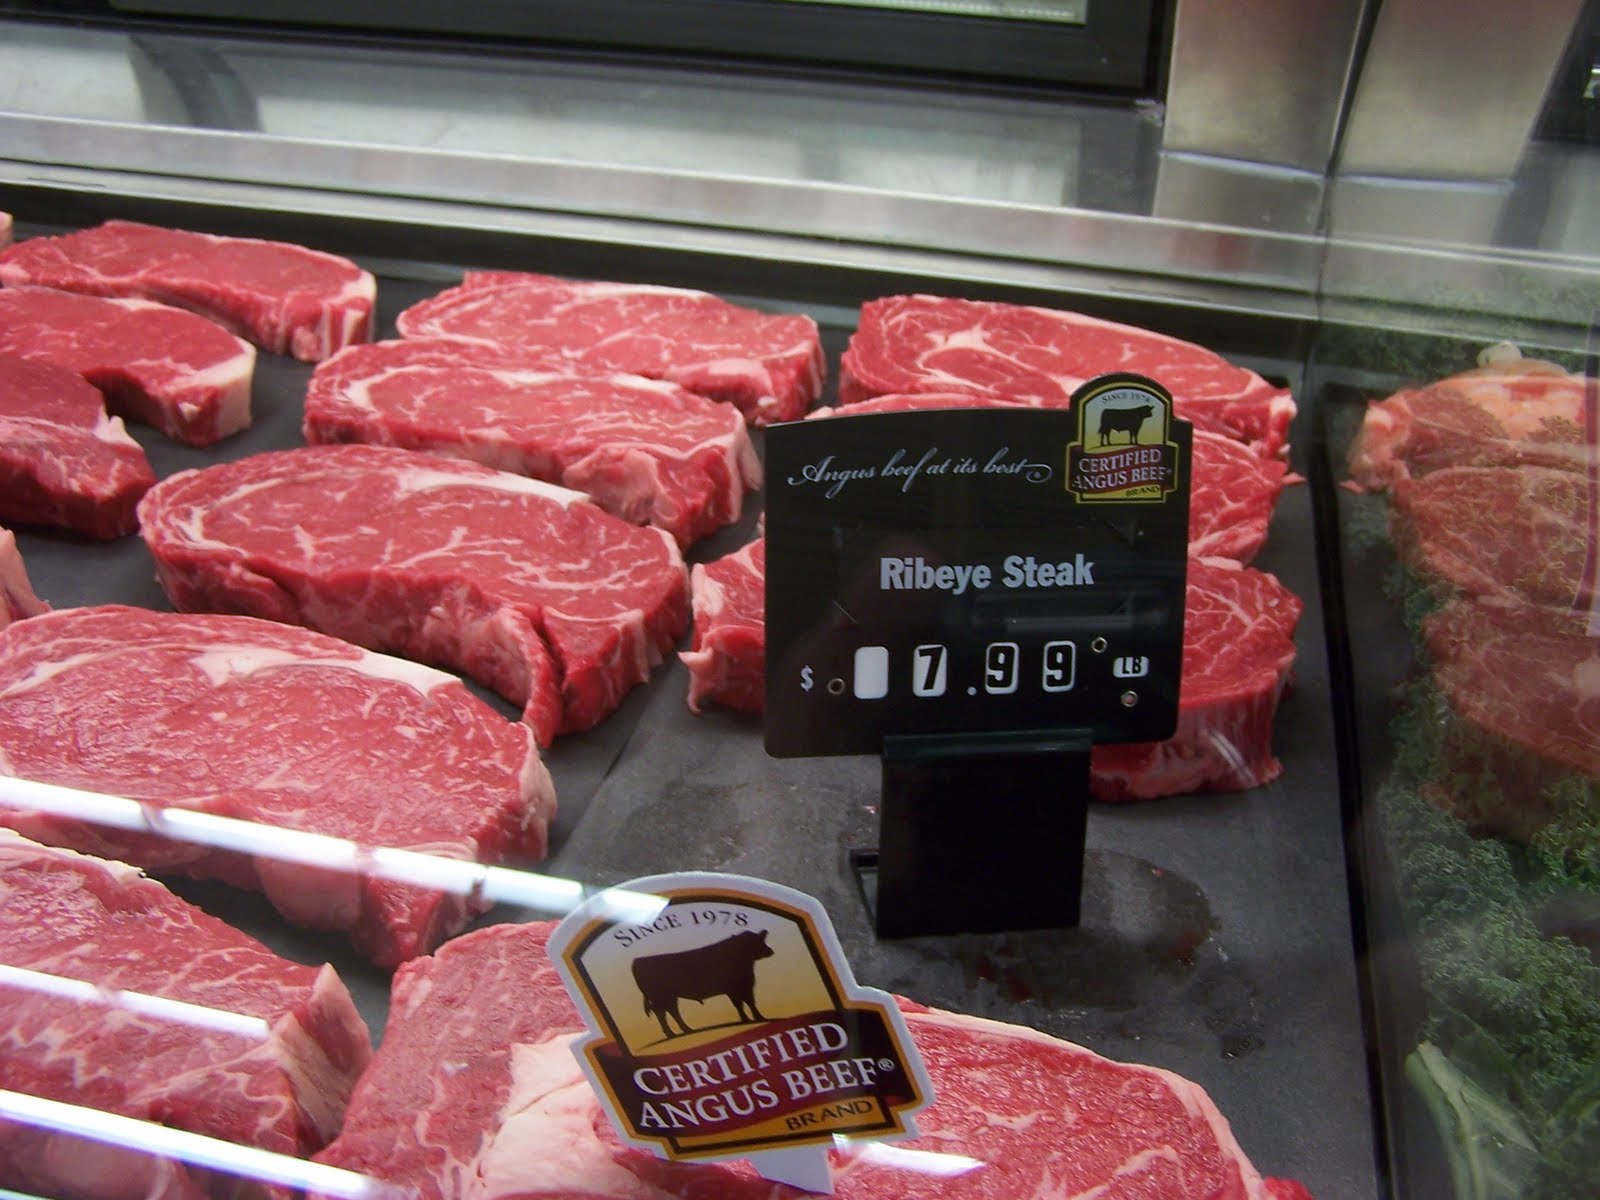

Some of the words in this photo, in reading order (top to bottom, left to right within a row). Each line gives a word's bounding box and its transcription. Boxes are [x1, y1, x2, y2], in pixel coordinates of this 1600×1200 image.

[787, 455, 875, 499] Angus
[880, 447, 937, 492] beef
[927, 458, 950, 474] at
[953, 457, 978, 473] its
[983, 447, 1052, 483] best
[1079, 448, 1161, 473] CERTIFIED
[1072, 470, 1128, 489] ANGUS
[1125, 485, 1160, 497] BRAND
[880, 557, 992, 595] Ribeye
[1002, 553, 1095, 588] Steak
[800, 665, 814, 692] $
[614, 913, 682, 948] SINCE
[691, 910, 749, 928] 1978
[633, 1023, 848, 1095] CERTIFIED
[640, 1079, 778, 1128] ANGUS
[785, 1100, 873, 1131] BRAND
